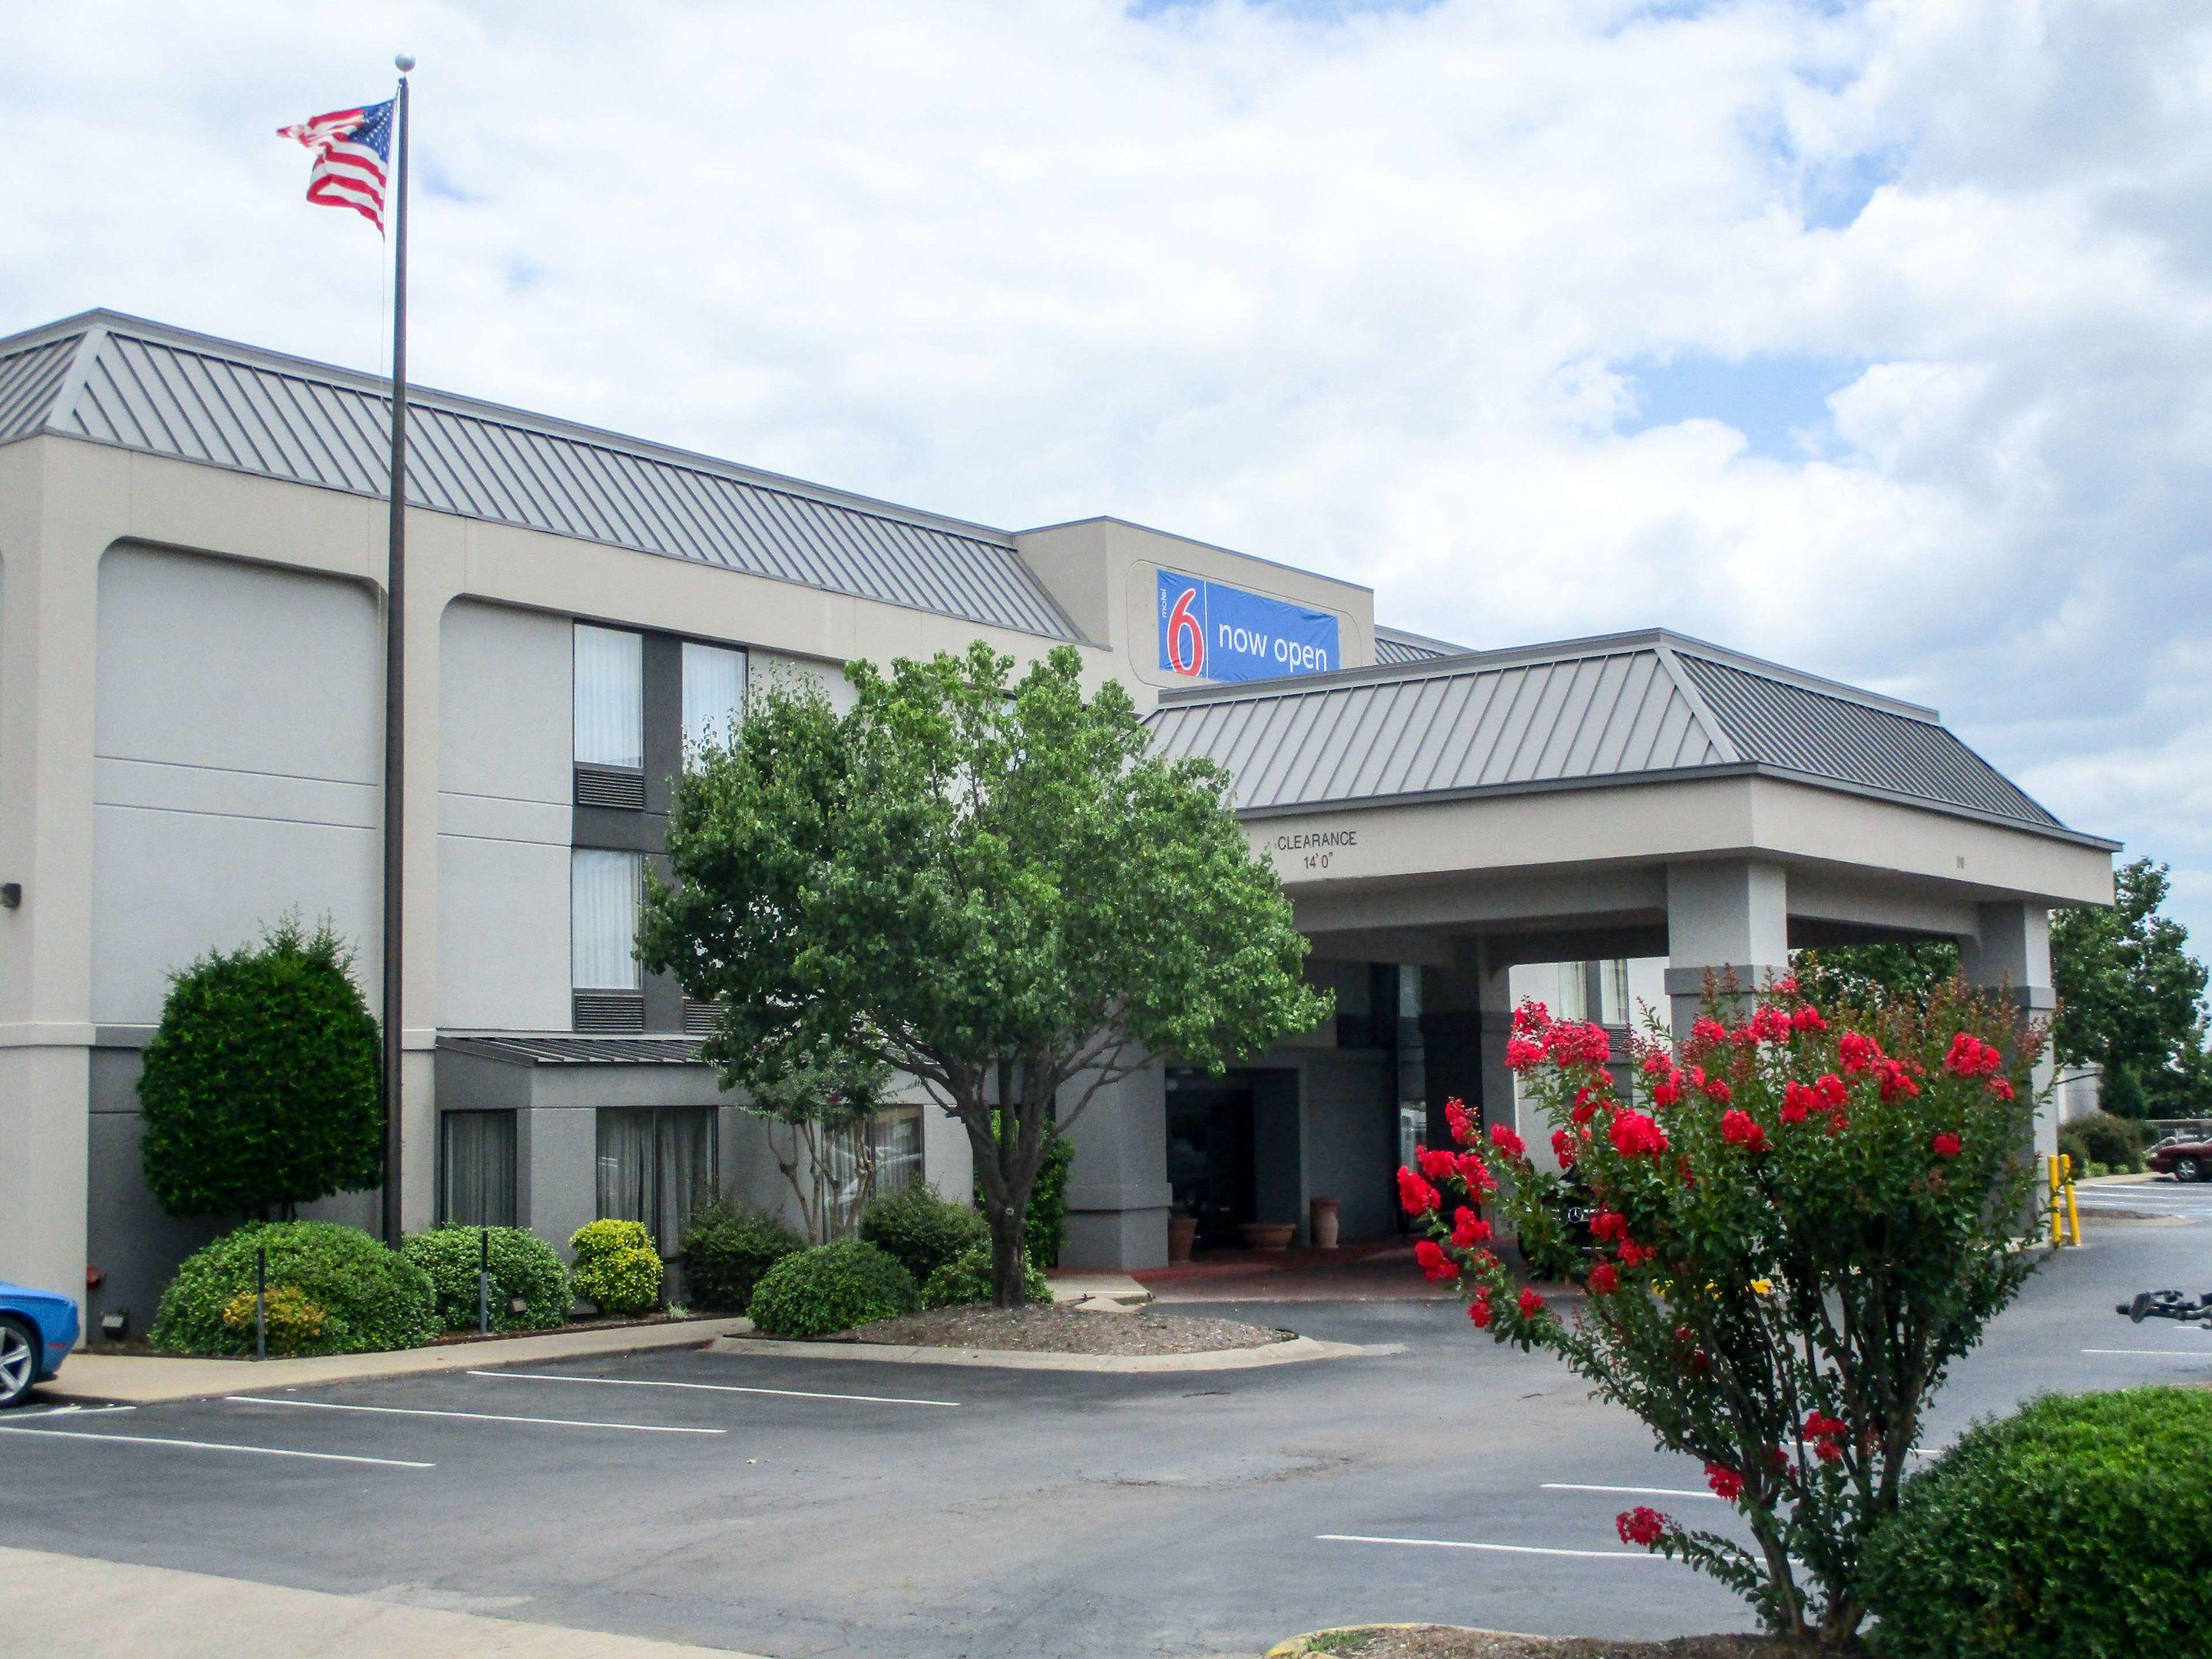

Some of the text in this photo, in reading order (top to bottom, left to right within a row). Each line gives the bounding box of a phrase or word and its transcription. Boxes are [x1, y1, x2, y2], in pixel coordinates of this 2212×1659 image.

[1167, 588, 1204, 677] 6
[1219, 623, 1327, 673] now open
[1277, 831, 1357, 850] CLEARANCE
